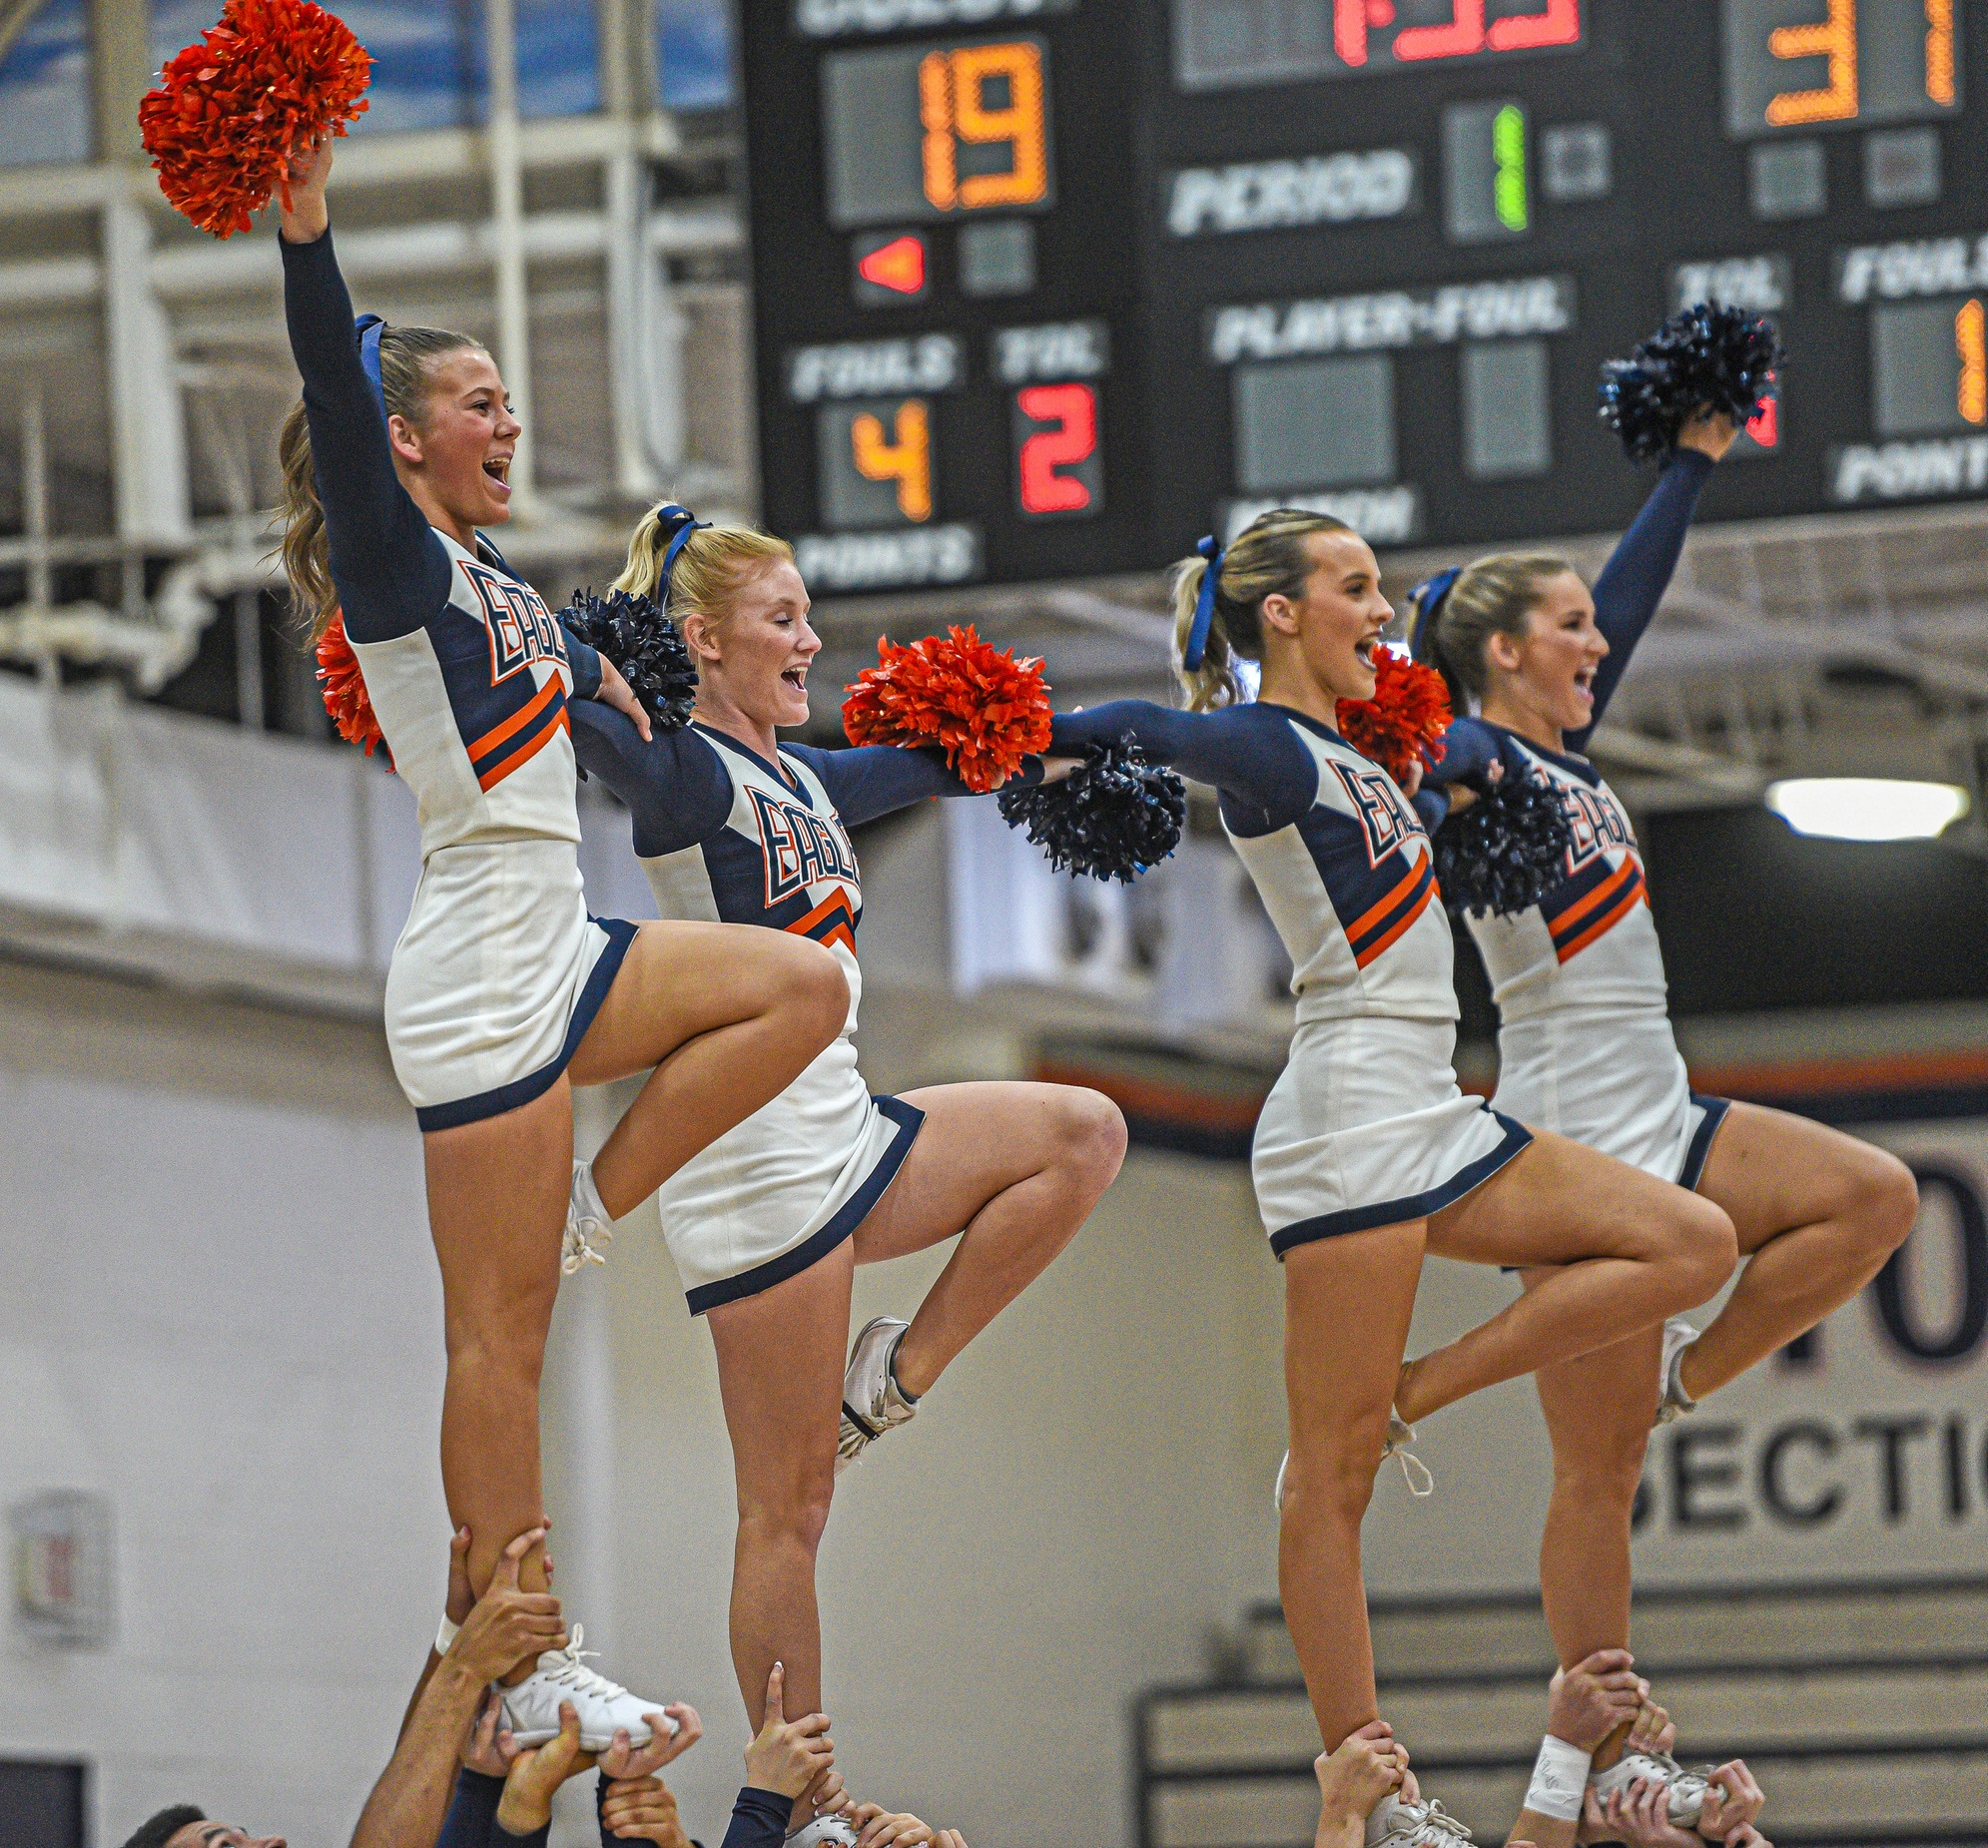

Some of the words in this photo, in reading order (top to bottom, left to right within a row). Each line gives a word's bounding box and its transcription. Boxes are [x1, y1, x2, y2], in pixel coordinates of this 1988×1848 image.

[920, 42, 1047, 210] 19
[1493, 104, 1528, 232] 1
[851, 399, 932, 522] 4
[1017, 381, 1098, 514] 2
[743, 784, 861, 910] EAGL
[1632, 1416, 1988, 1536] ECTI
